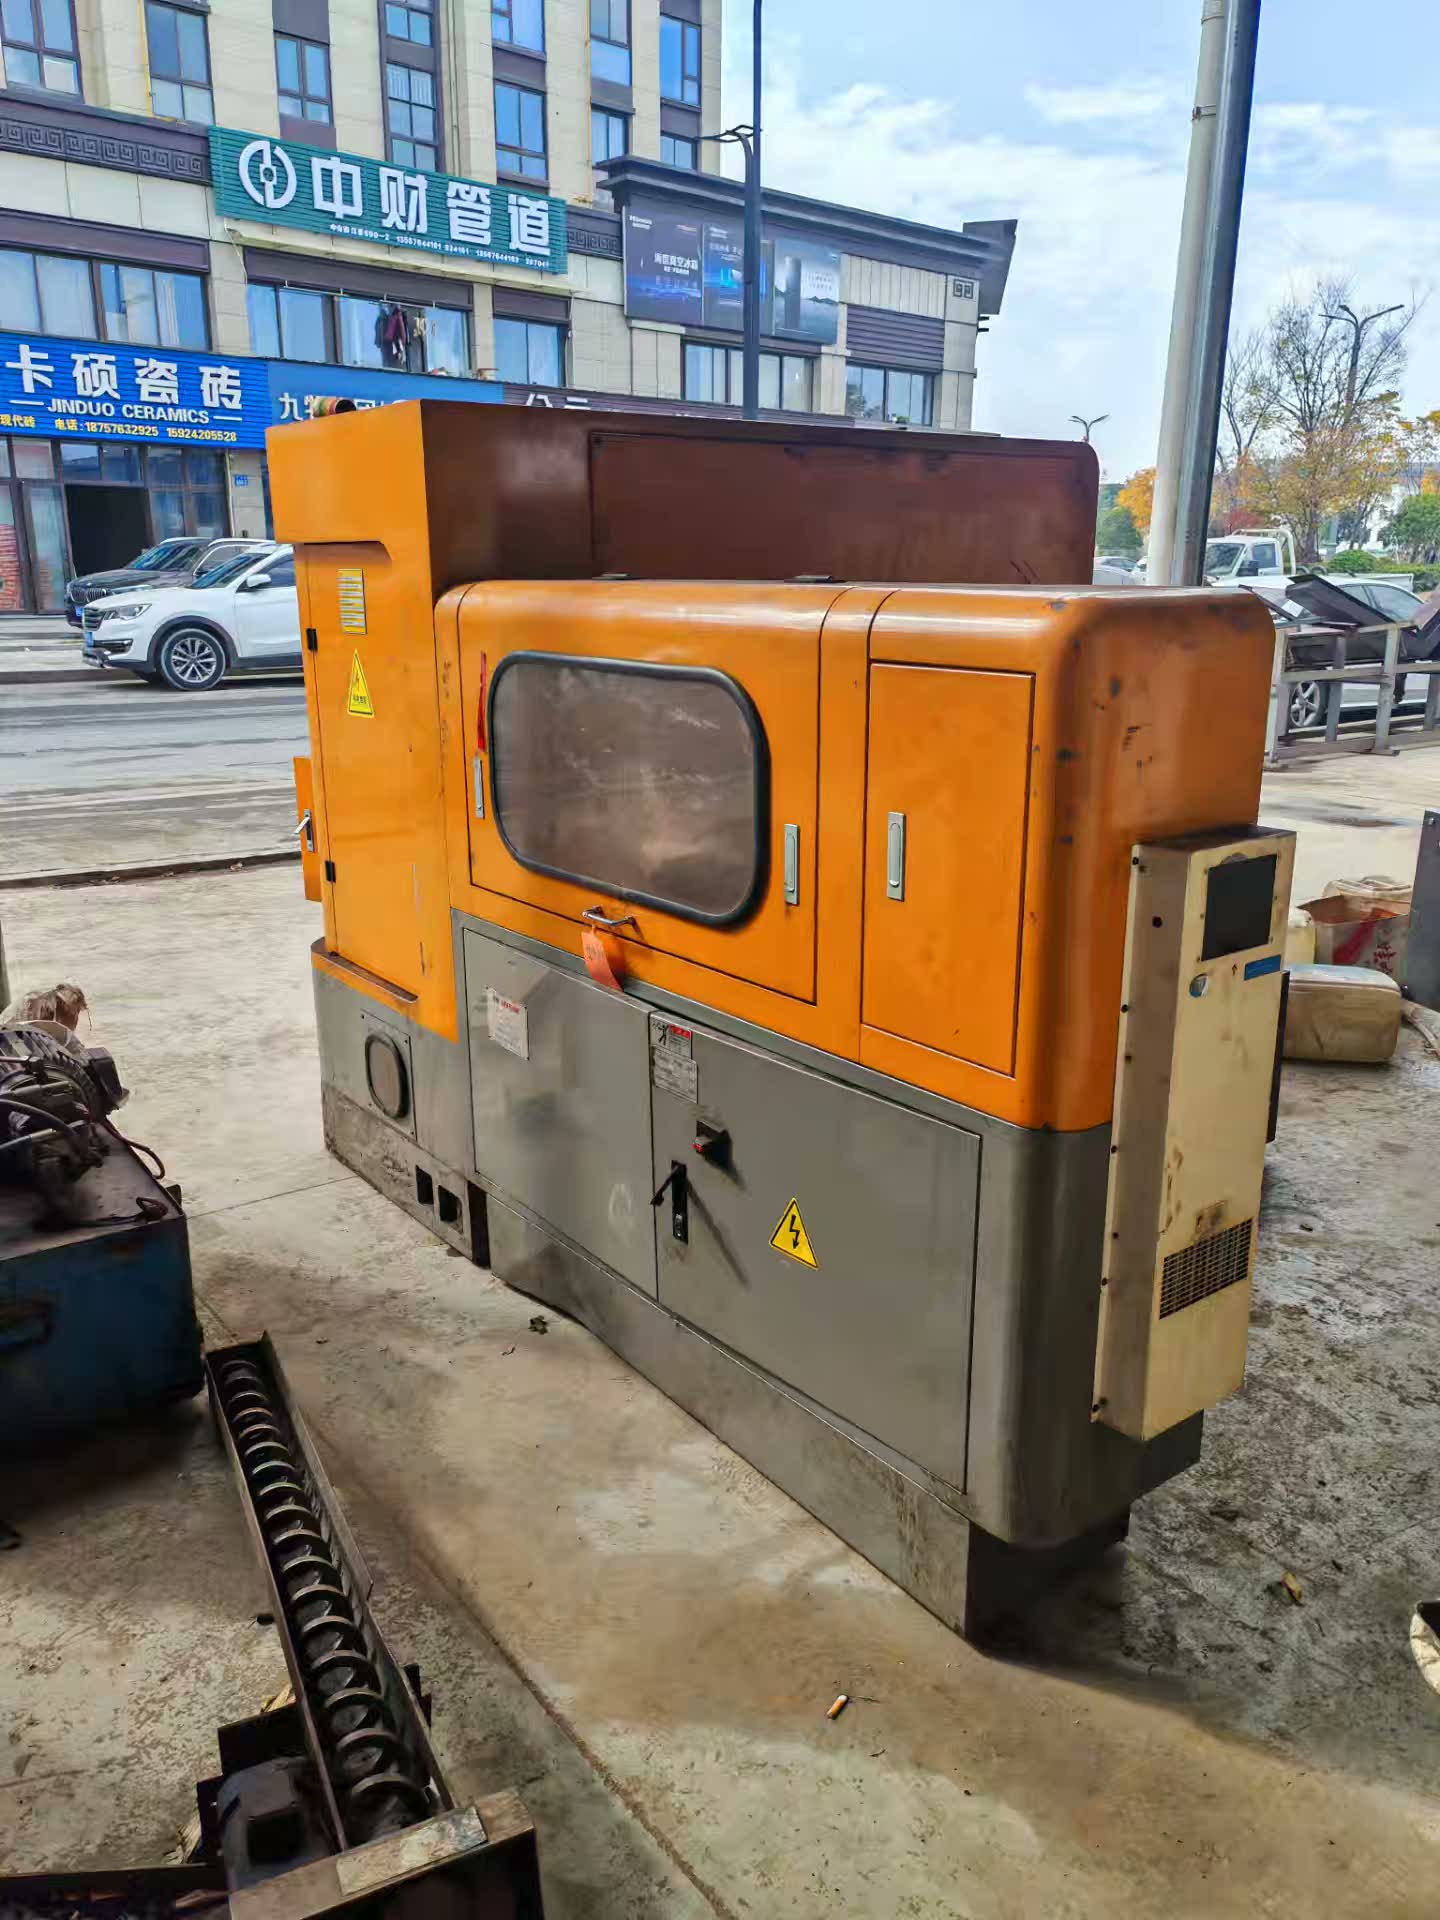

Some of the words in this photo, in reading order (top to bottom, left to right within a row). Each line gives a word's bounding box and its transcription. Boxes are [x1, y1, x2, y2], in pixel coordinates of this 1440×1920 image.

[311, 156, 551, 256] 中财管道
[5, 344, 243, 410] 卡硕瓷砖
[48, 398, 115, 416] JINDUO
[122, 404, 209, 424] CERAMICS
[166, 427, 237, 442] 15924205528
